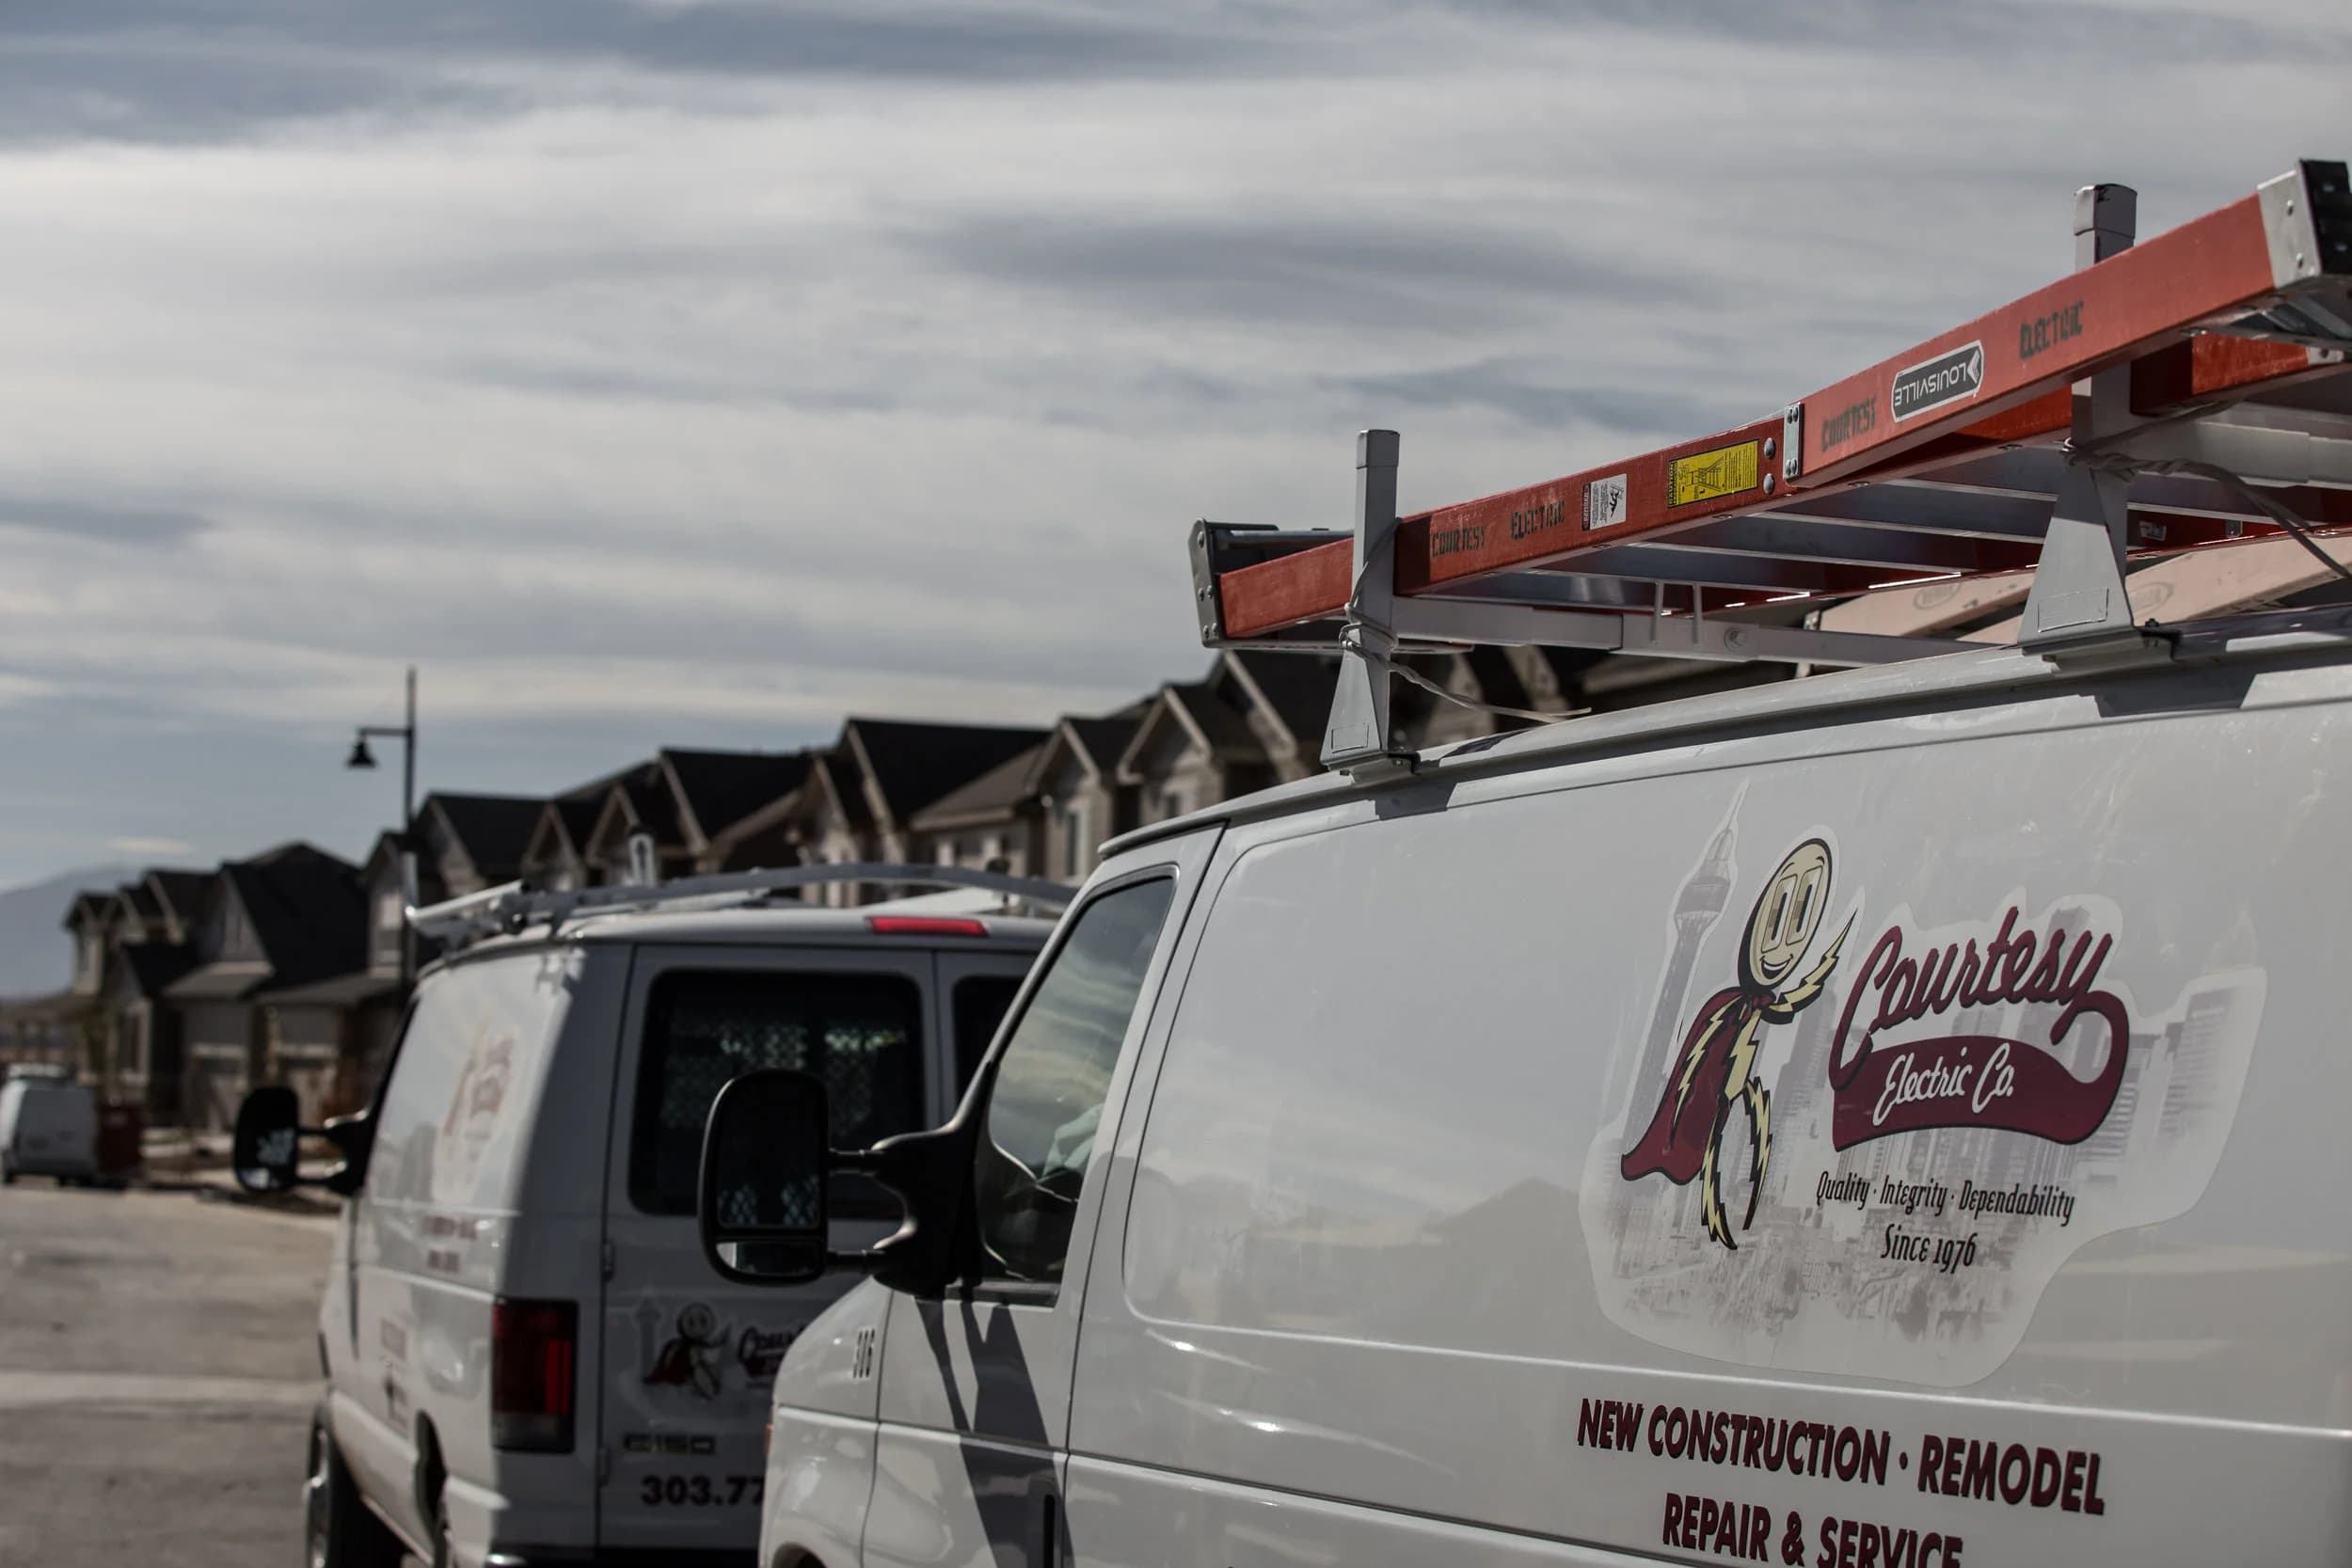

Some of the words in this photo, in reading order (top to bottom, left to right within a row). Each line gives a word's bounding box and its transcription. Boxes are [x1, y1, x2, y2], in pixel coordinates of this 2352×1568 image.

[1894, 361, 1967, 406] LOUISVILLE
[1828, 906, 2128, 1092] Courtesy
[1872, 1047, 1972, 1127] Electric
[1972, 1042, 2015, 1114] Co.
[1817, 1170, 1870, 1212] Quality
[1880, 1175, 1947, 1217] Integrity
[1959, 1180, 2075, 1227] Dependability
[1880, 1223, 1931, 1262] Since
[1932, 1232, 1978, 1275] 1976
[1577, 1398, 1645, 1452] NEW
[1648, 1404, 1891, 1486] CONSTRUCTION
[1917, 1433, 2106, 1516] REMODEL
[1662, 1492, 1771, 1562] REPAIR
[1781, 1511, 1805, 1567] &
[1817, 1516, 1963, 1568] SERVICE
